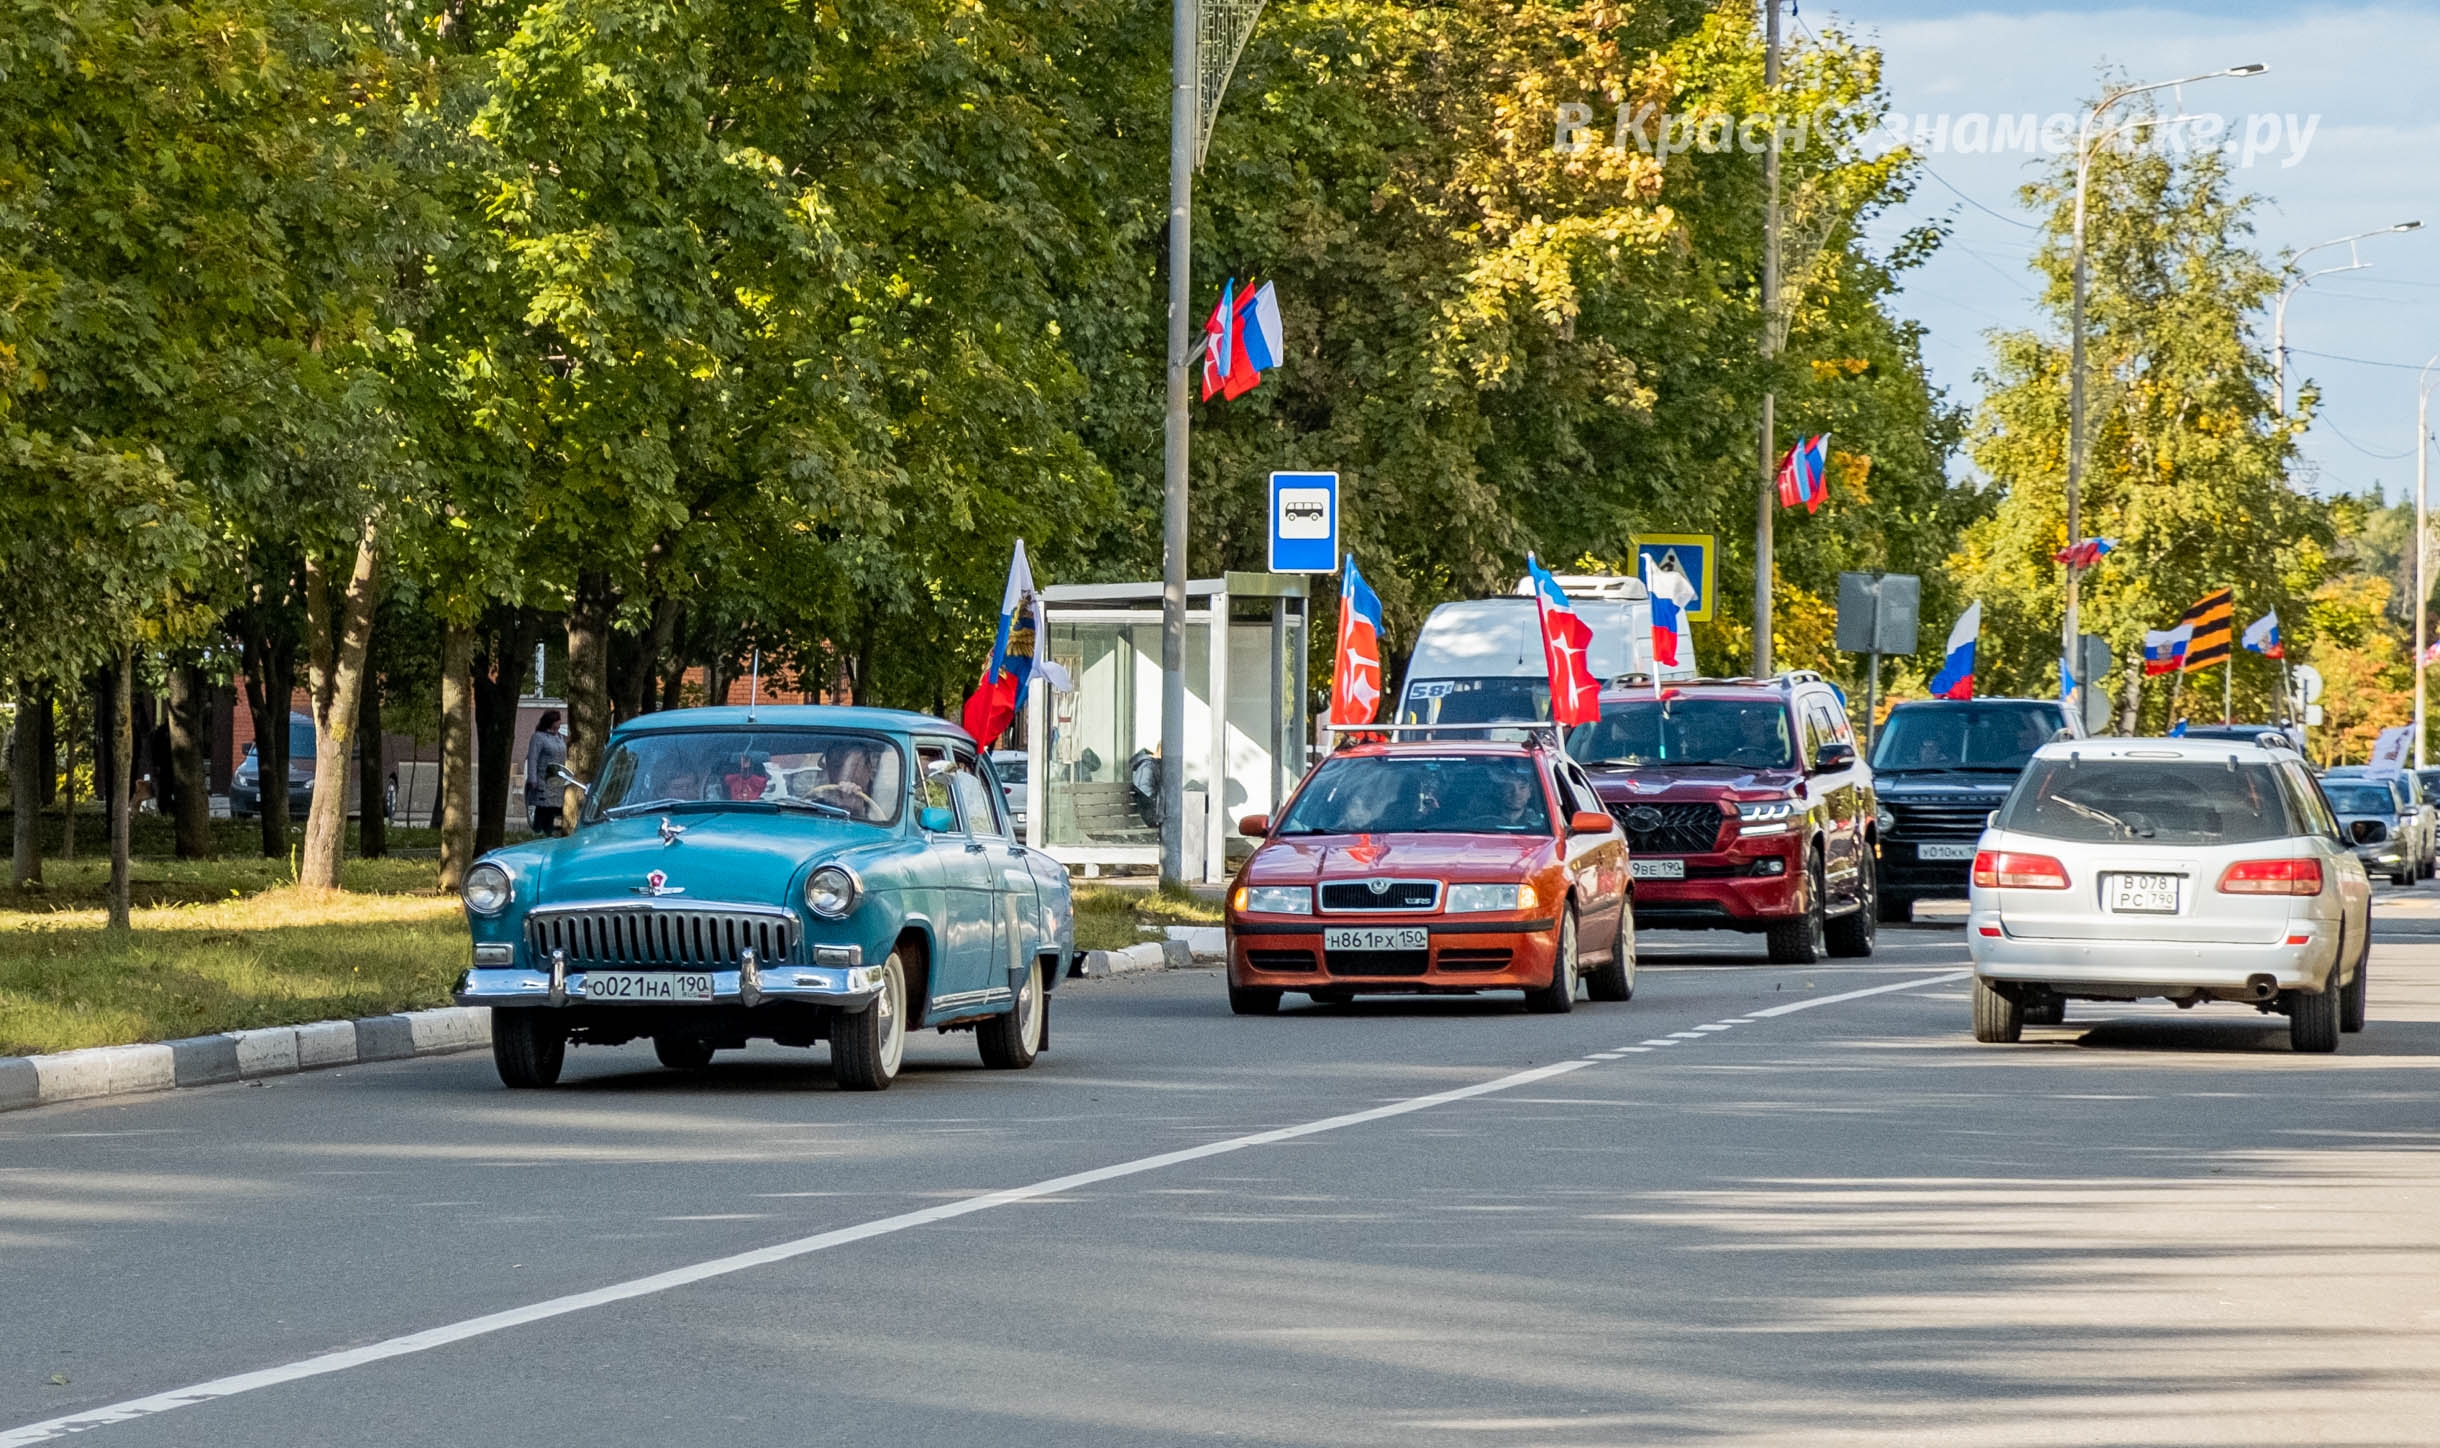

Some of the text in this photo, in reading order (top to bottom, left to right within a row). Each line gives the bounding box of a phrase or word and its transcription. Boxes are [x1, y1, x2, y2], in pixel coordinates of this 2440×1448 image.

[1632, 862, 1657, 876] 9ВЕ
[2151, 893, 2174, 904] 790
[1330, 930, 1423, 948] Н861РХ 150
[592, 975, 707, 997] О021НА 190
